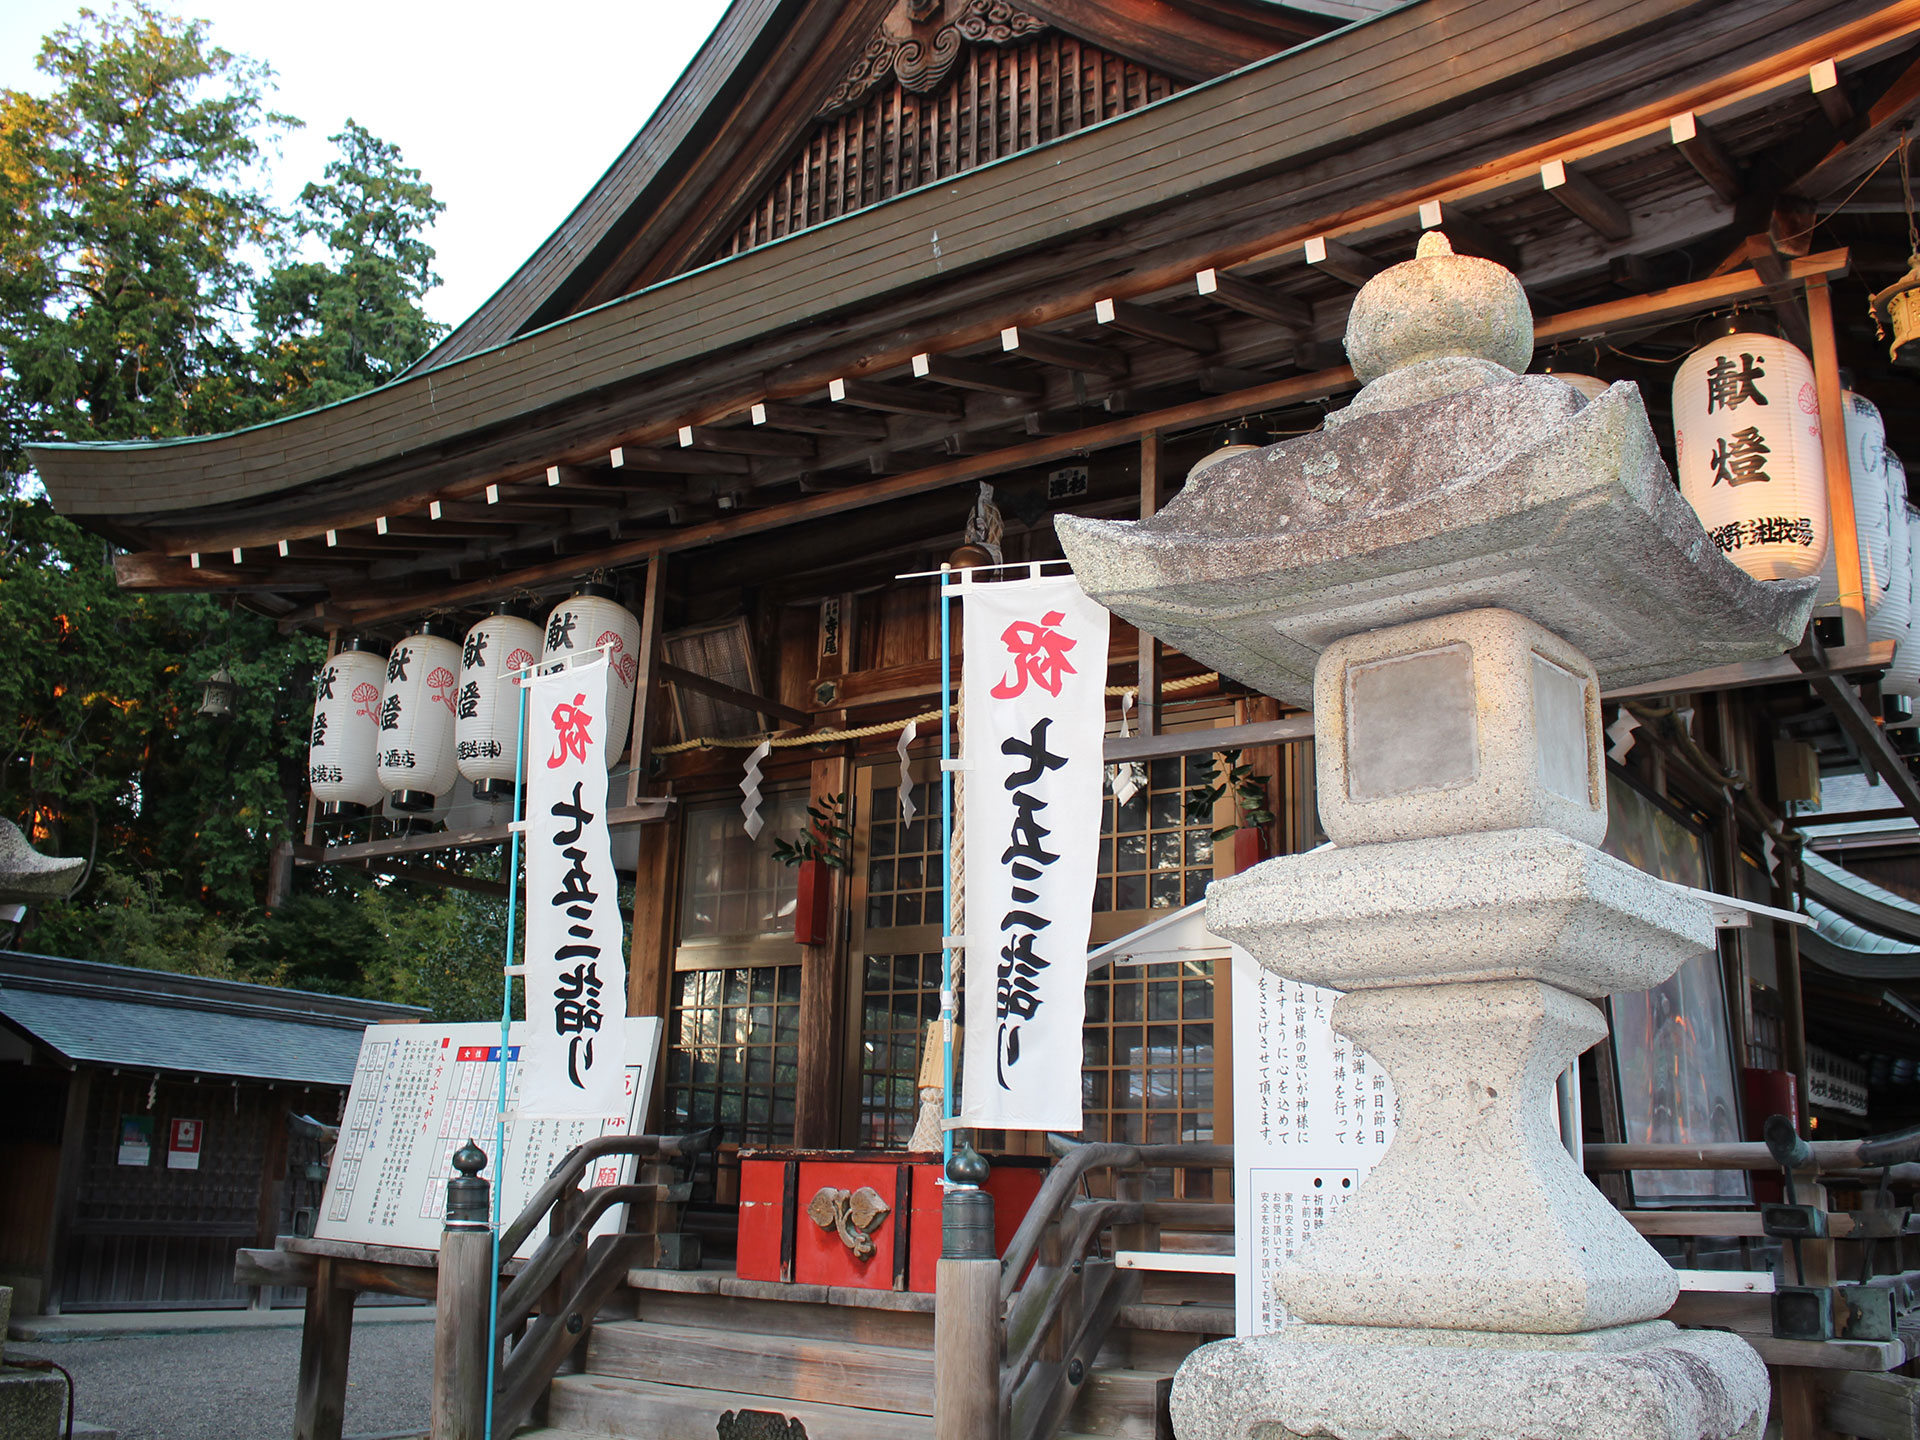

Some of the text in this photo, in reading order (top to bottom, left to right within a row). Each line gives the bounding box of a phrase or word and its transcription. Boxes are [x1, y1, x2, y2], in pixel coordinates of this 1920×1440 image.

[1707, 353, 1771, 487] 献燈
[421, 1053, 447, 1137] 八方ふさがり
[1276, 980, 1290, 1144] ますように心を込めて
[1373, 1075, 1386, 1145] 節目節目
